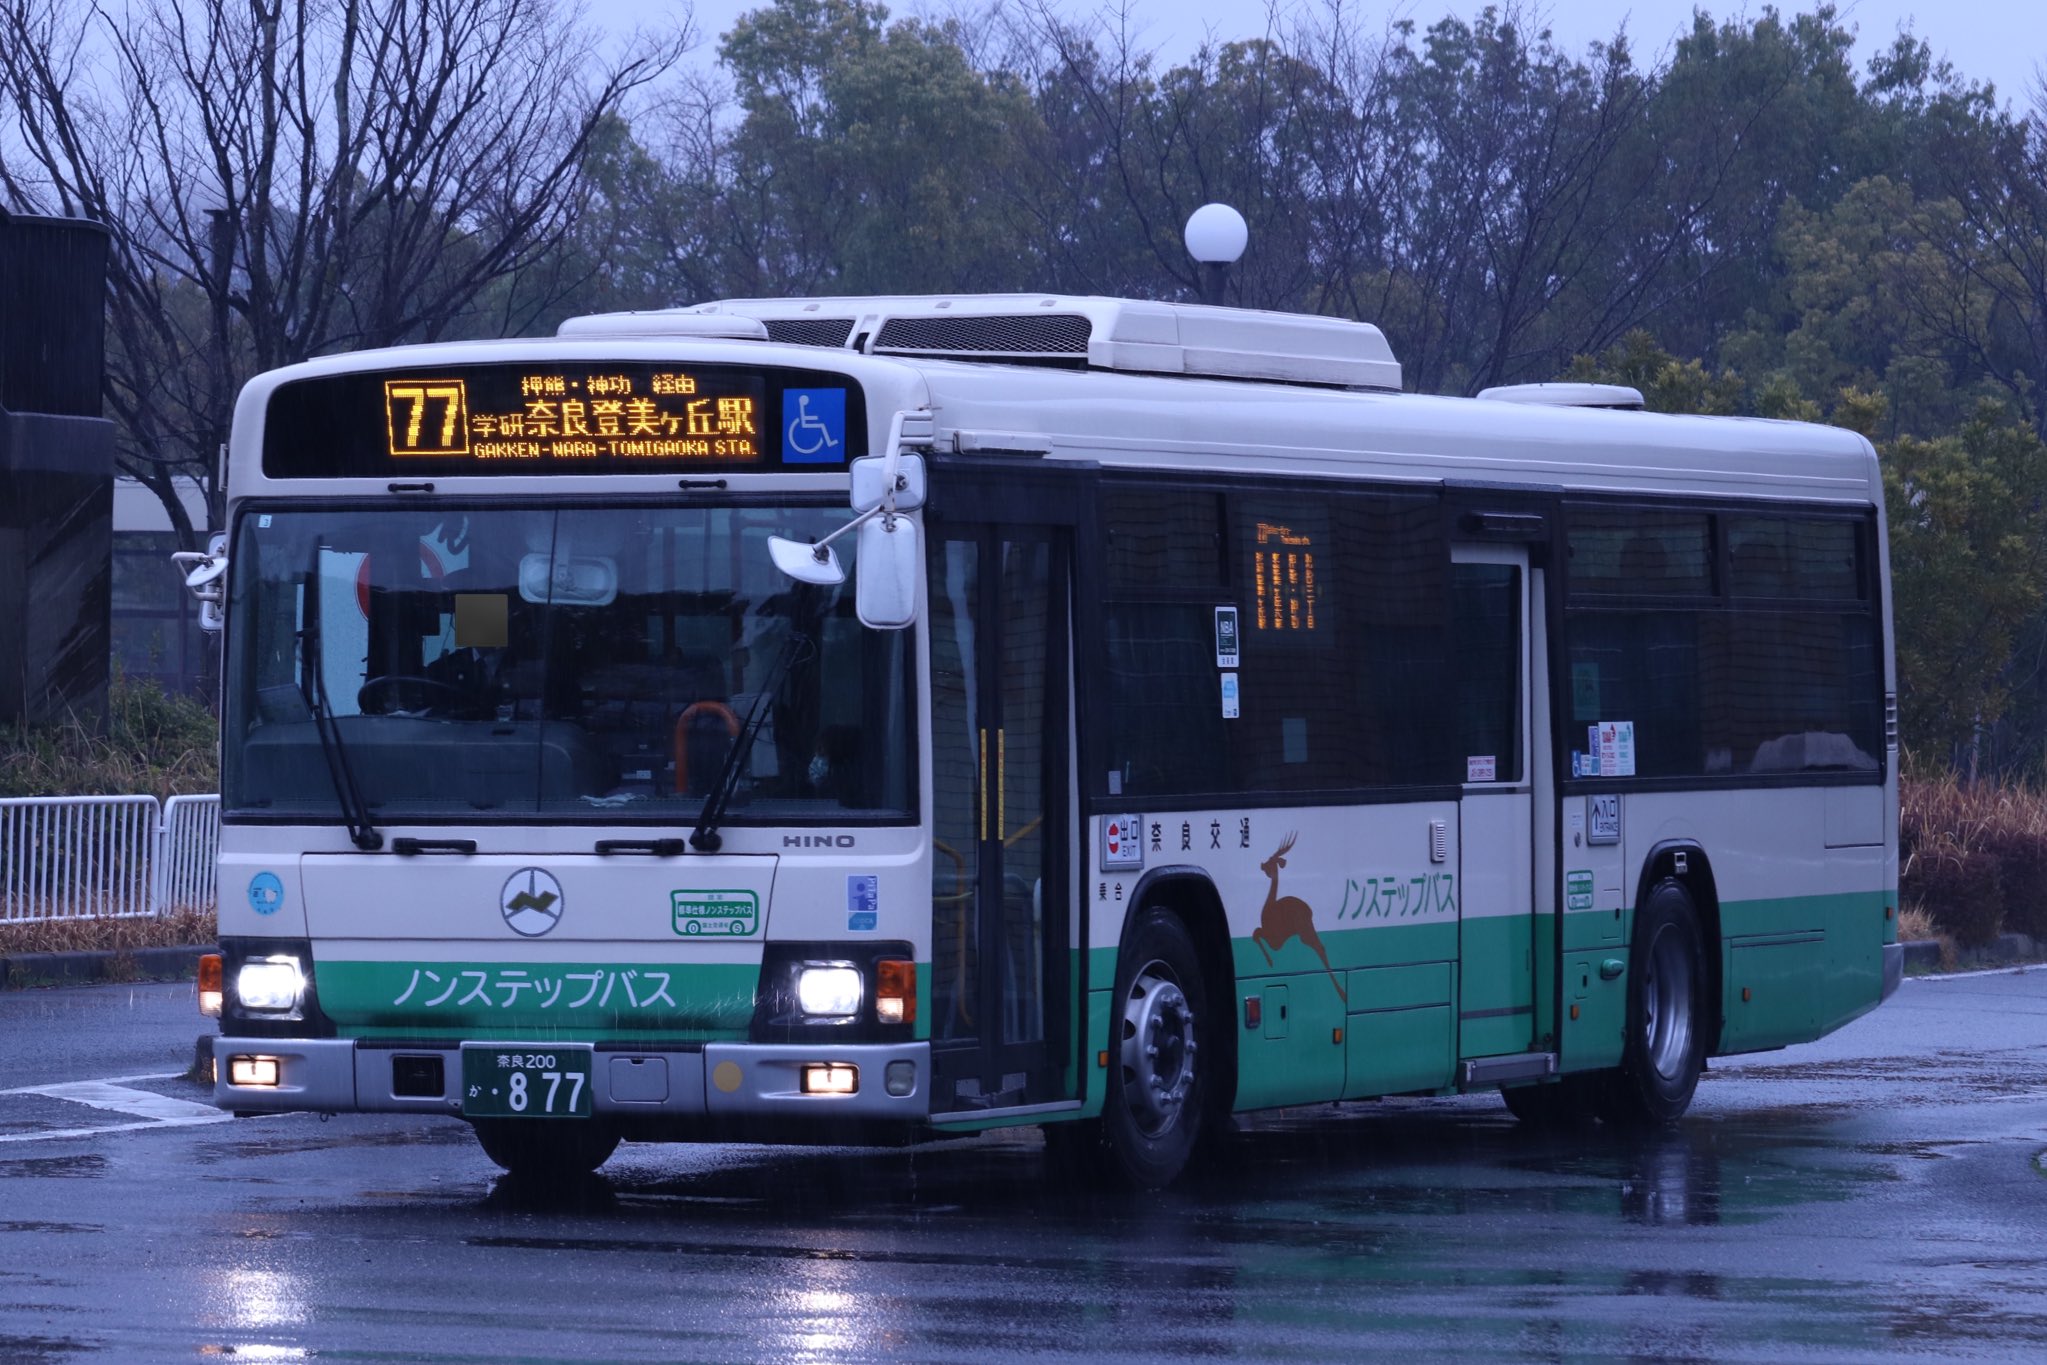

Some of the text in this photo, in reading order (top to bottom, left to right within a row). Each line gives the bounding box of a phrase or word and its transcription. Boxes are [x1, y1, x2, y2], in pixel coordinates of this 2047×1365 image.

[521, 374, 695, 396] 押熊・神功 経由
[391, 388, 459, 447] 77
[472, 398, 756, 438] 学研奈良登美ヶ丘駅
[473, 439, 757, 459] GAKKEN-NARA-TOMIGAOKA STA.
[1601, 799, 1616, 819] 入口
[783, 835, 856, 848] HINO
[1120, 818, 1139, 842] 出口
[1151, 817, 1250, 852] 奈良交通
[1122, 845, 1136, 857] EXIT
[1099, 882, 1123, 901] 乗合
[1337, 871, 1456, 921] ノンステップバス
[393, 968, 677, 1009] ノンステップバス
